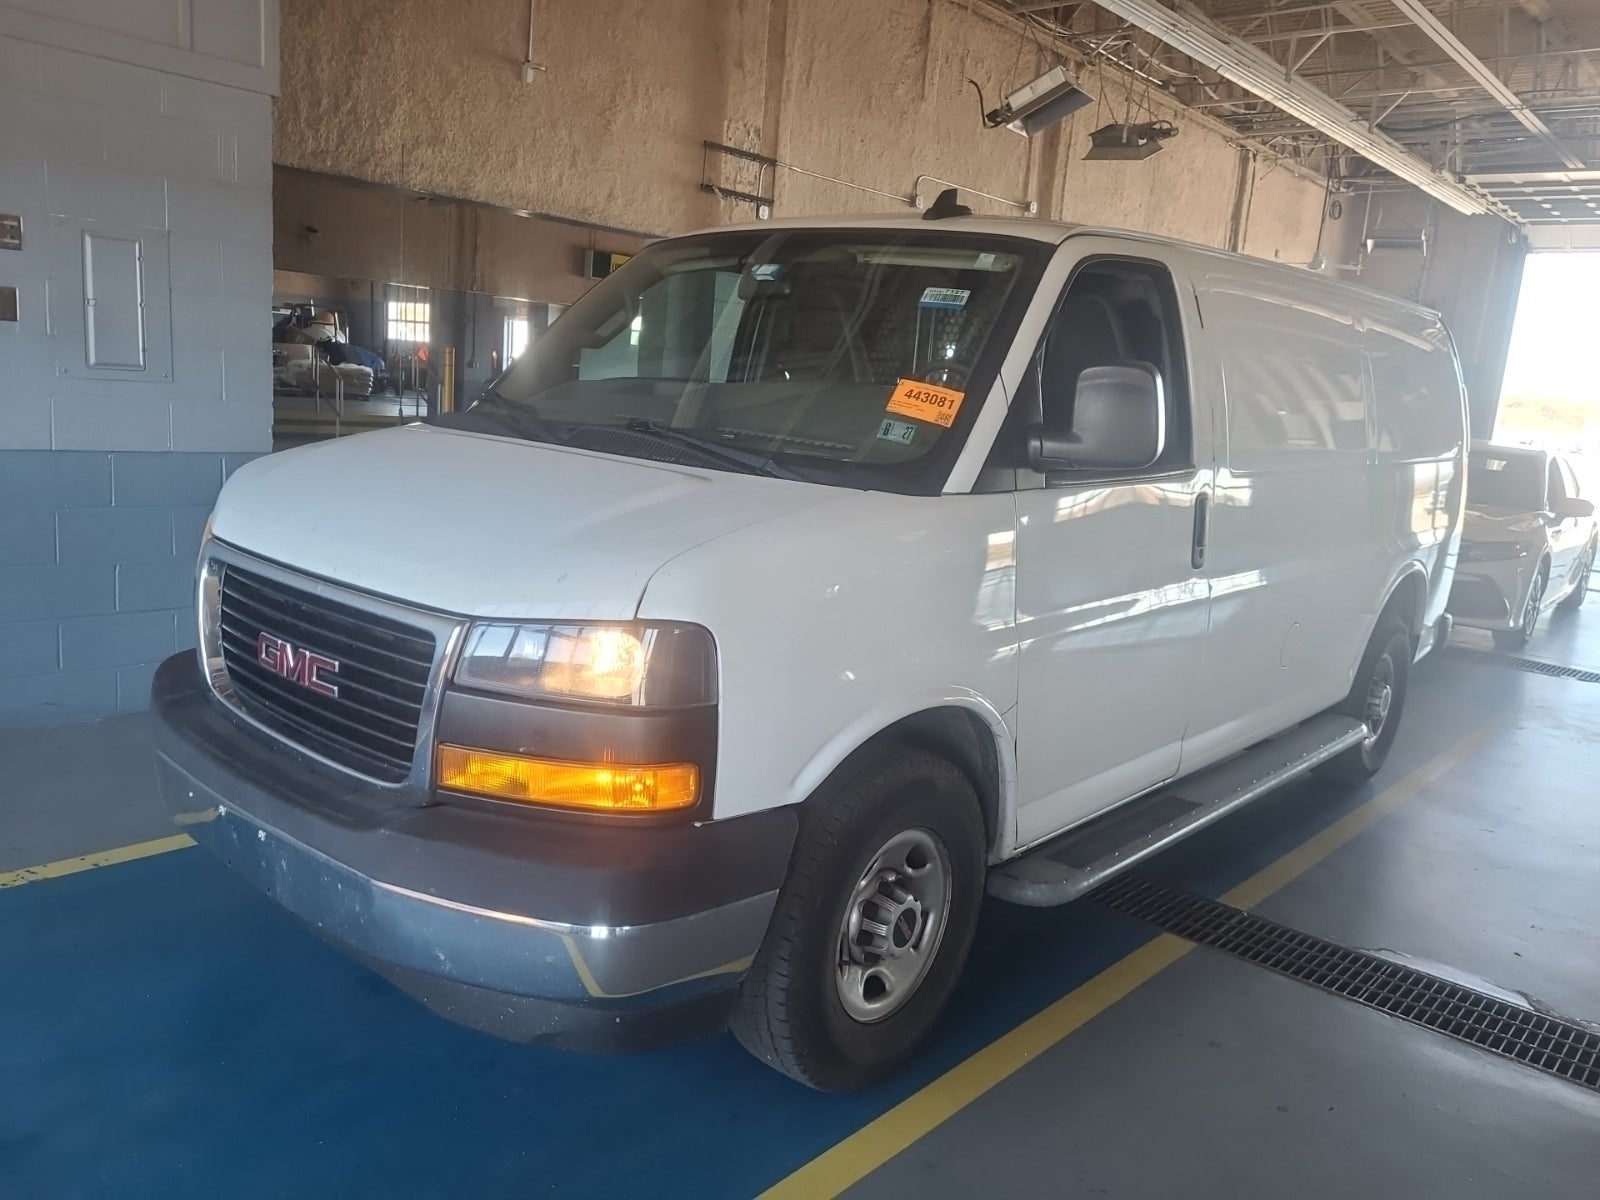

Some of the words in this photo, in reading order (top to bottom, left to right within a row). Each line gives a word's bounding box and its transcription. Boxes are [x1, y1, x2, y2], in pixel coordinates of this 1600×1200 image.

[904, 389, 955, 409] 443081
[902, 426, 914, 440] 27
[257, 631, 339, 698] GMC
